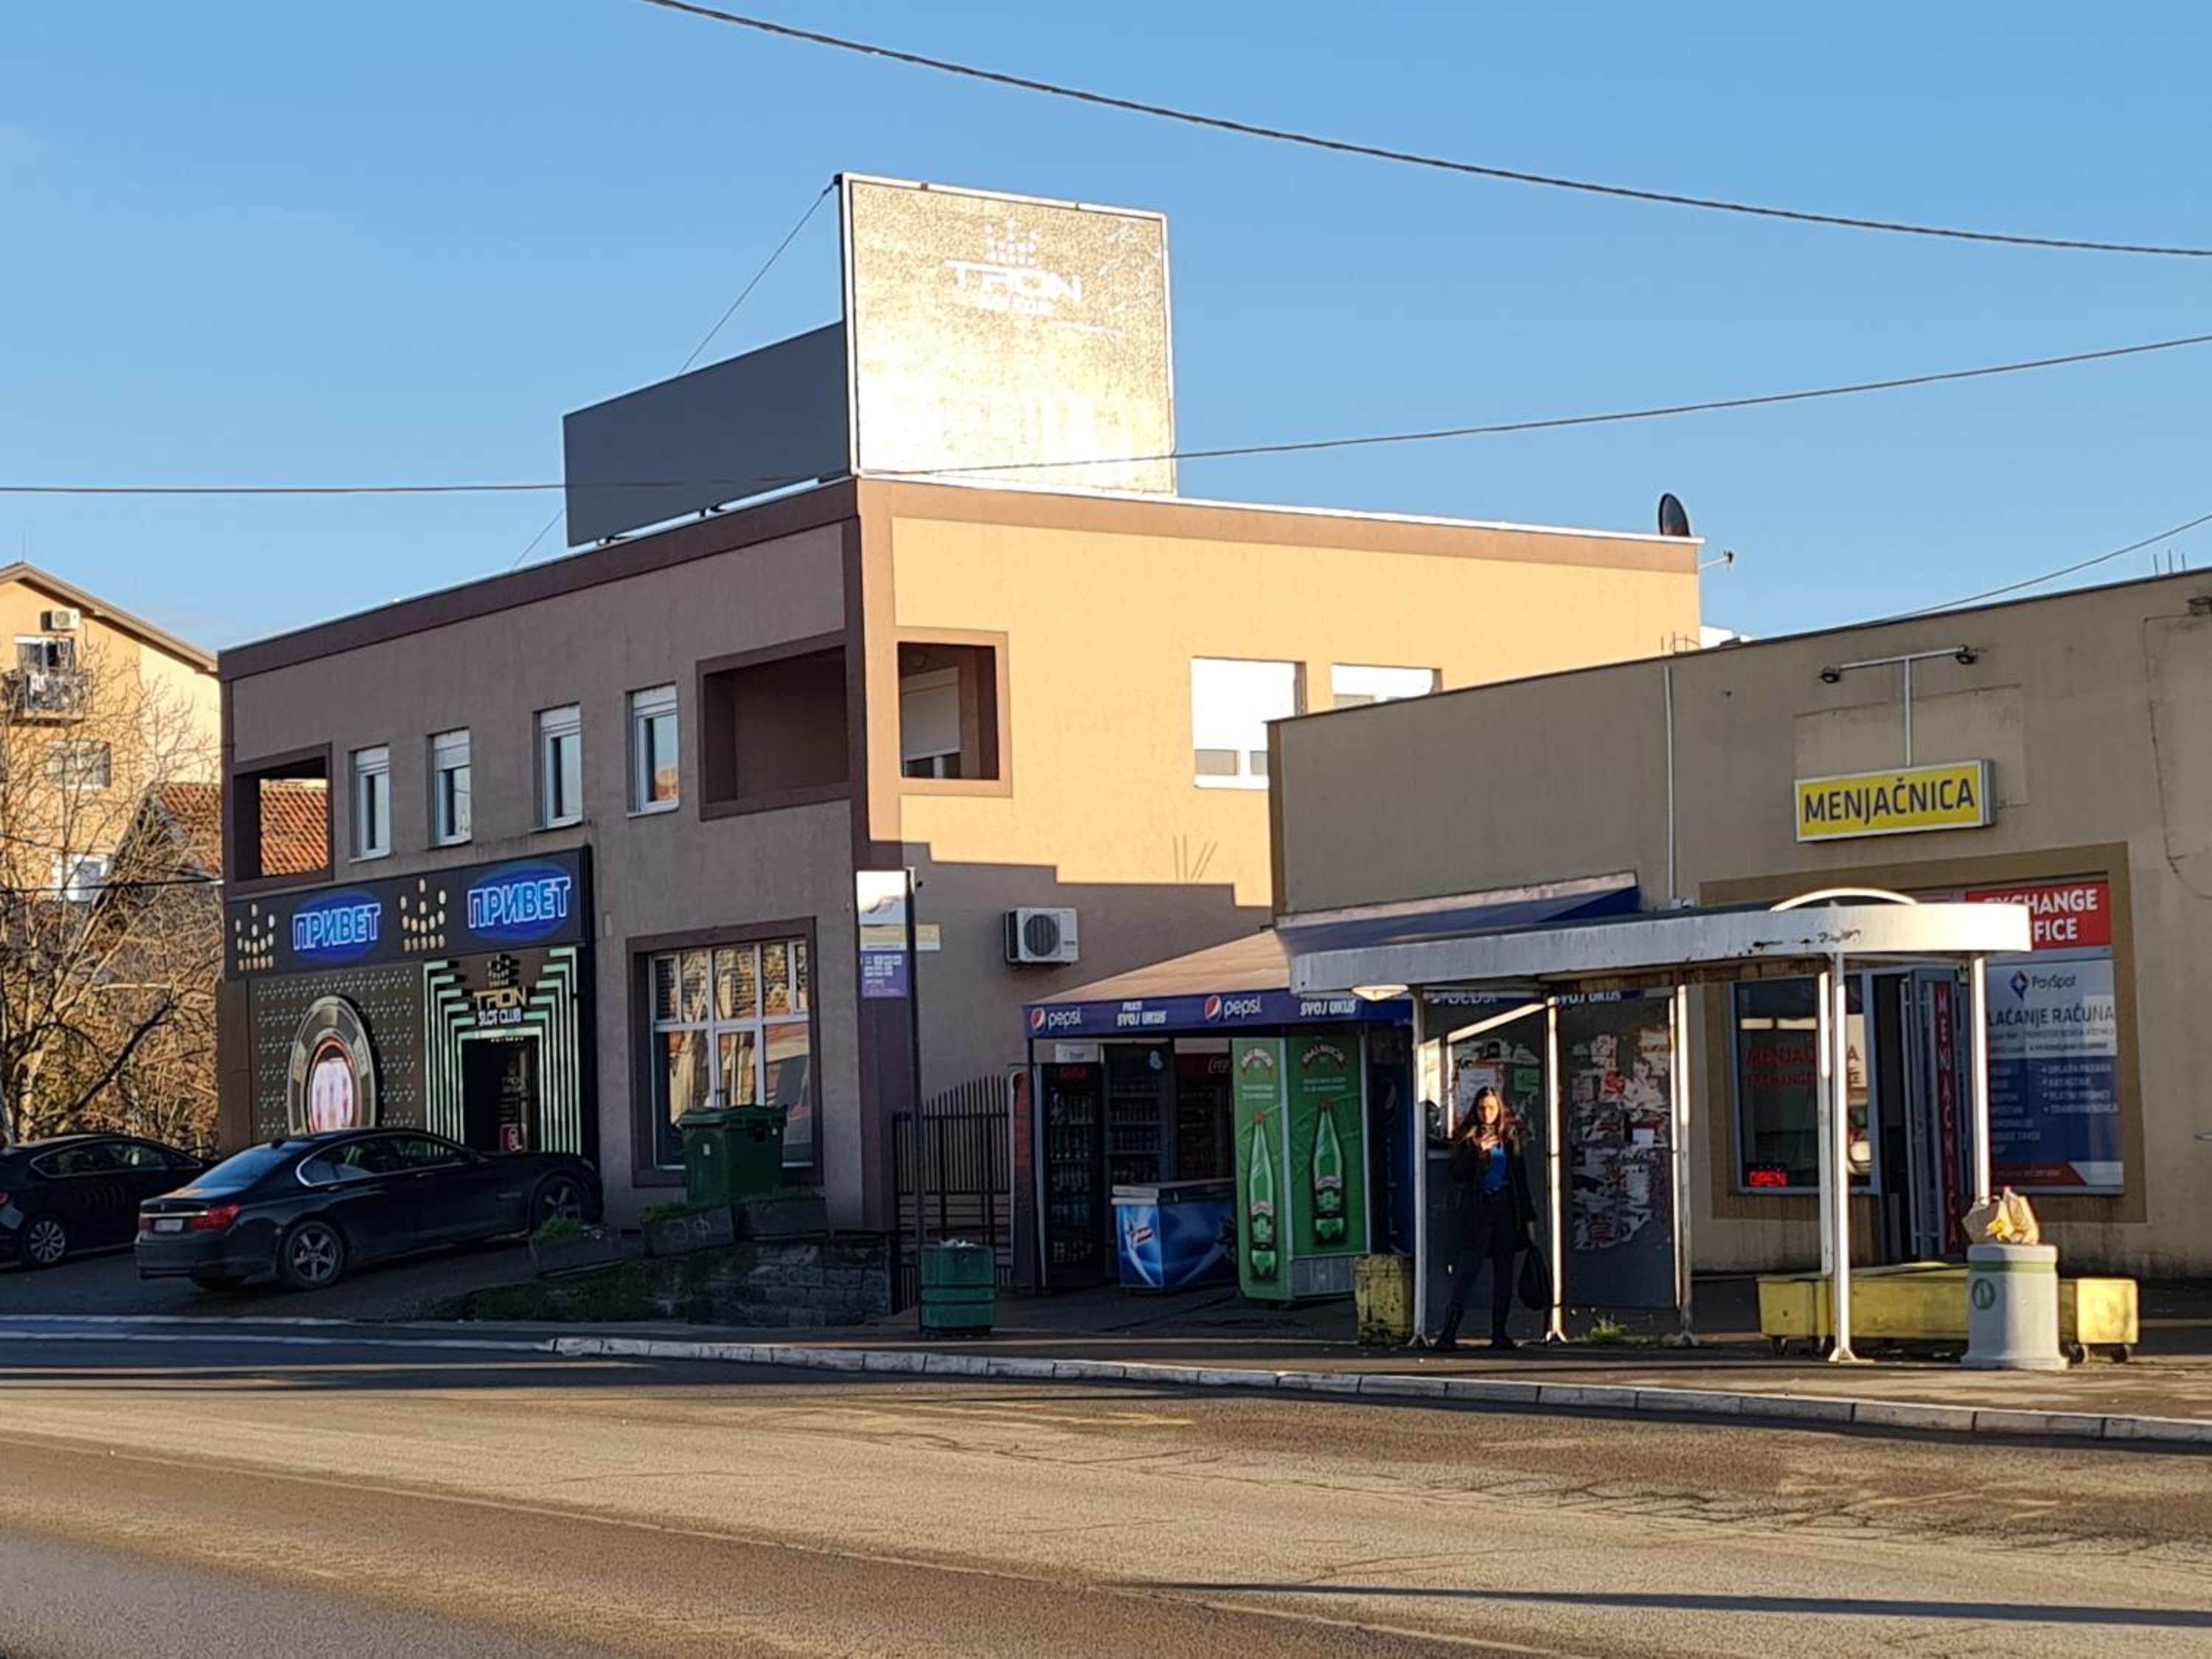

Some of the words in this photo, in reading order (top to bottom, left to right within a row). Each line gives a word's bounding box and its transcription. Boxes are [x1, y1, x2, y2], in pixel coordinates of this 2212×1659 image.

[1804, 777, 1975, 824] MENJAČNICA
[467, 876, 571, 929] ПРИВЕТ
[1983, 889, 2098, 915] HANGE
[292, 902, 381, 950] ПРИВЕТ
[2034, 918, 2078, 942] FICE
[1048, 1006, 1082, 1030] pepsi
[1224, 995, 1262, 1019] pepsi
